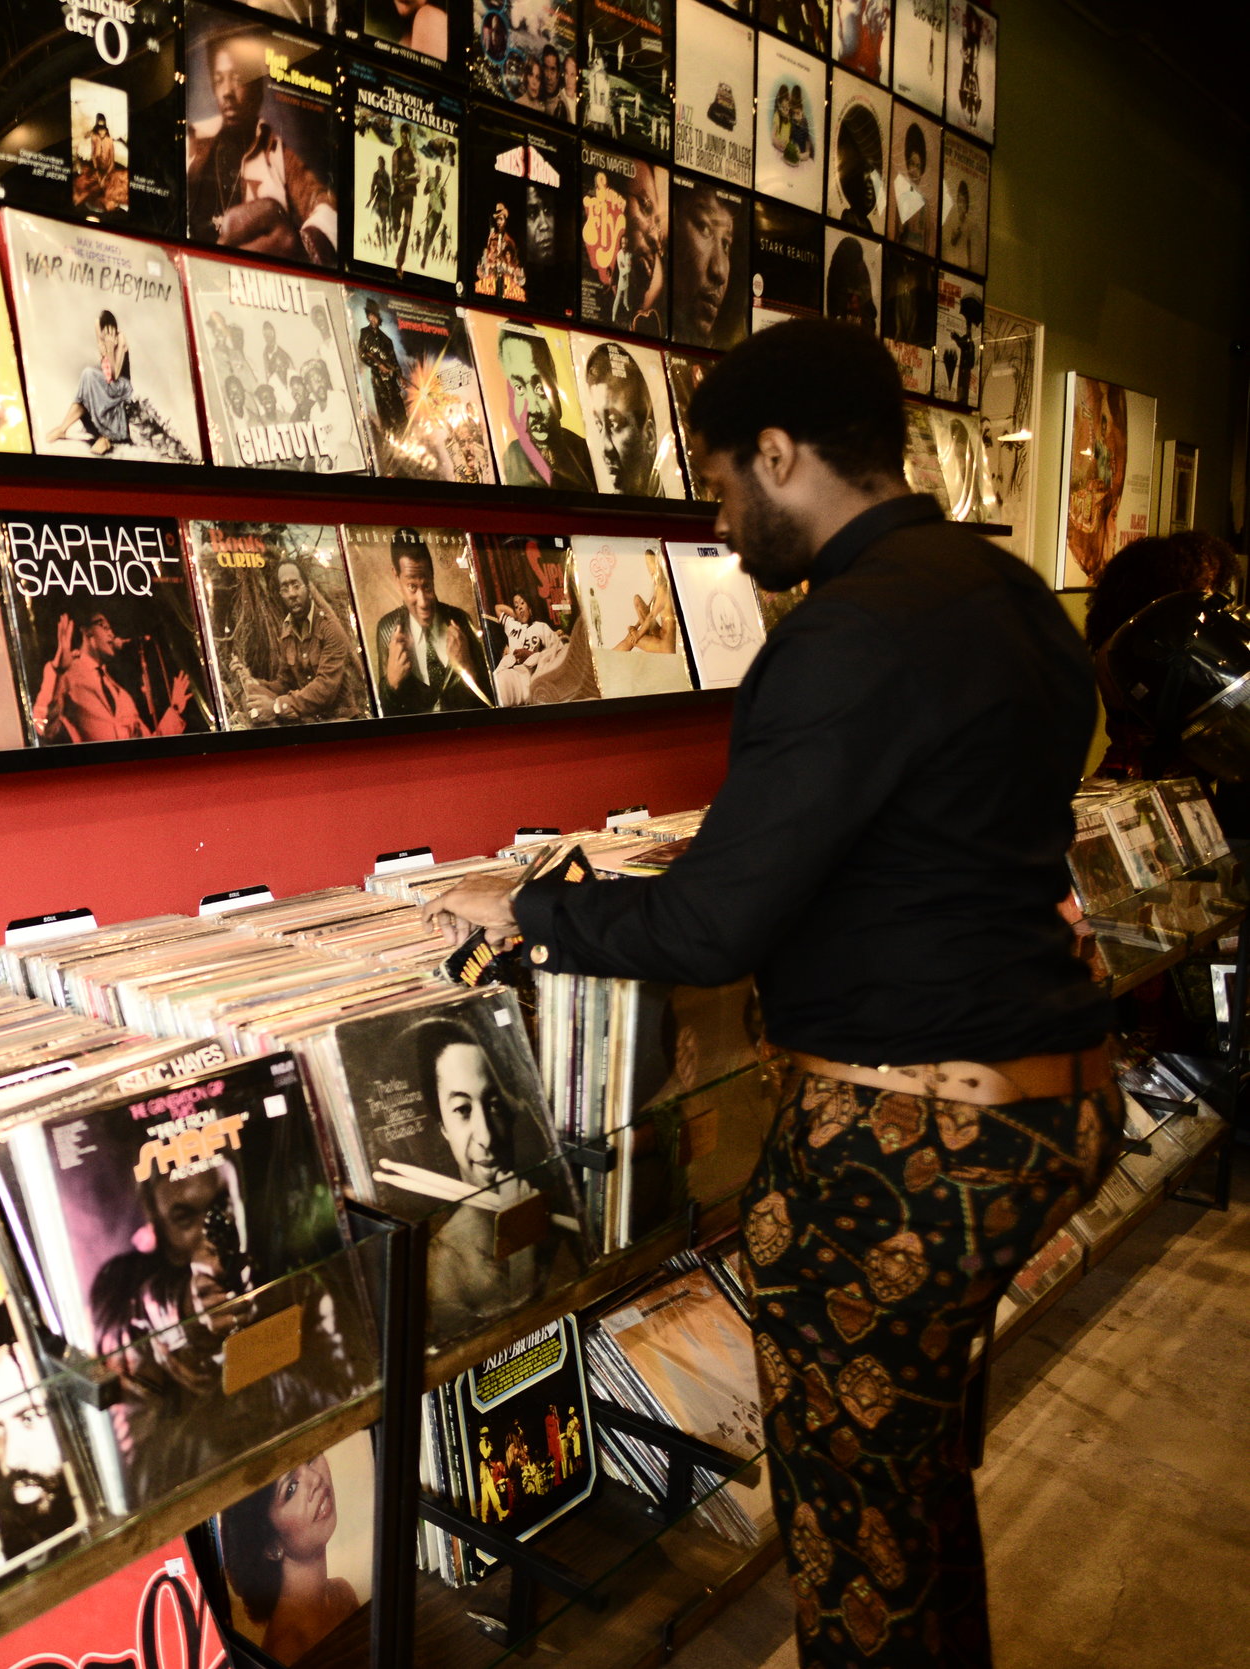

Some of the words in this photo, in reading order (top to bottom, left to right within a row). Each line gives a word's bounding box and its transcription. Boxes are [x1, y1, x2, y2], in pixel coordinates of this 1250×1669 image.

[65, 5, 95, 37] der
[95, 17, 128, 65] O
[291, 69, 332, 96] Harlem
[358, 88, 403, 117] NIGGER
[403, 92, 424, 110] SOUL
[425, 102, 434, 113] of
[581, 149, 606, 169] CURTIS
[606, 156, 637, 178] MAYFIELD
[760, 238, 784, 255] STARK
[26, 251, 64, 283] WAR
[99, 266, 172, 303] BABYLON
[397, 318, 421, 332] James
[421, 322, 449, 337] Brown
[7, 522, 180, 563] RAPHAEL
[347, 527, 396, 543] Luther
[401, 529, 466, 546] Vandross
[13, 558, 153, 597] SAADIQ
[43, 915, 57, 923] SOUL
[170, 1043, 226, 1077] HAYES
[509, 1320, 558, 1360] BROTHER
